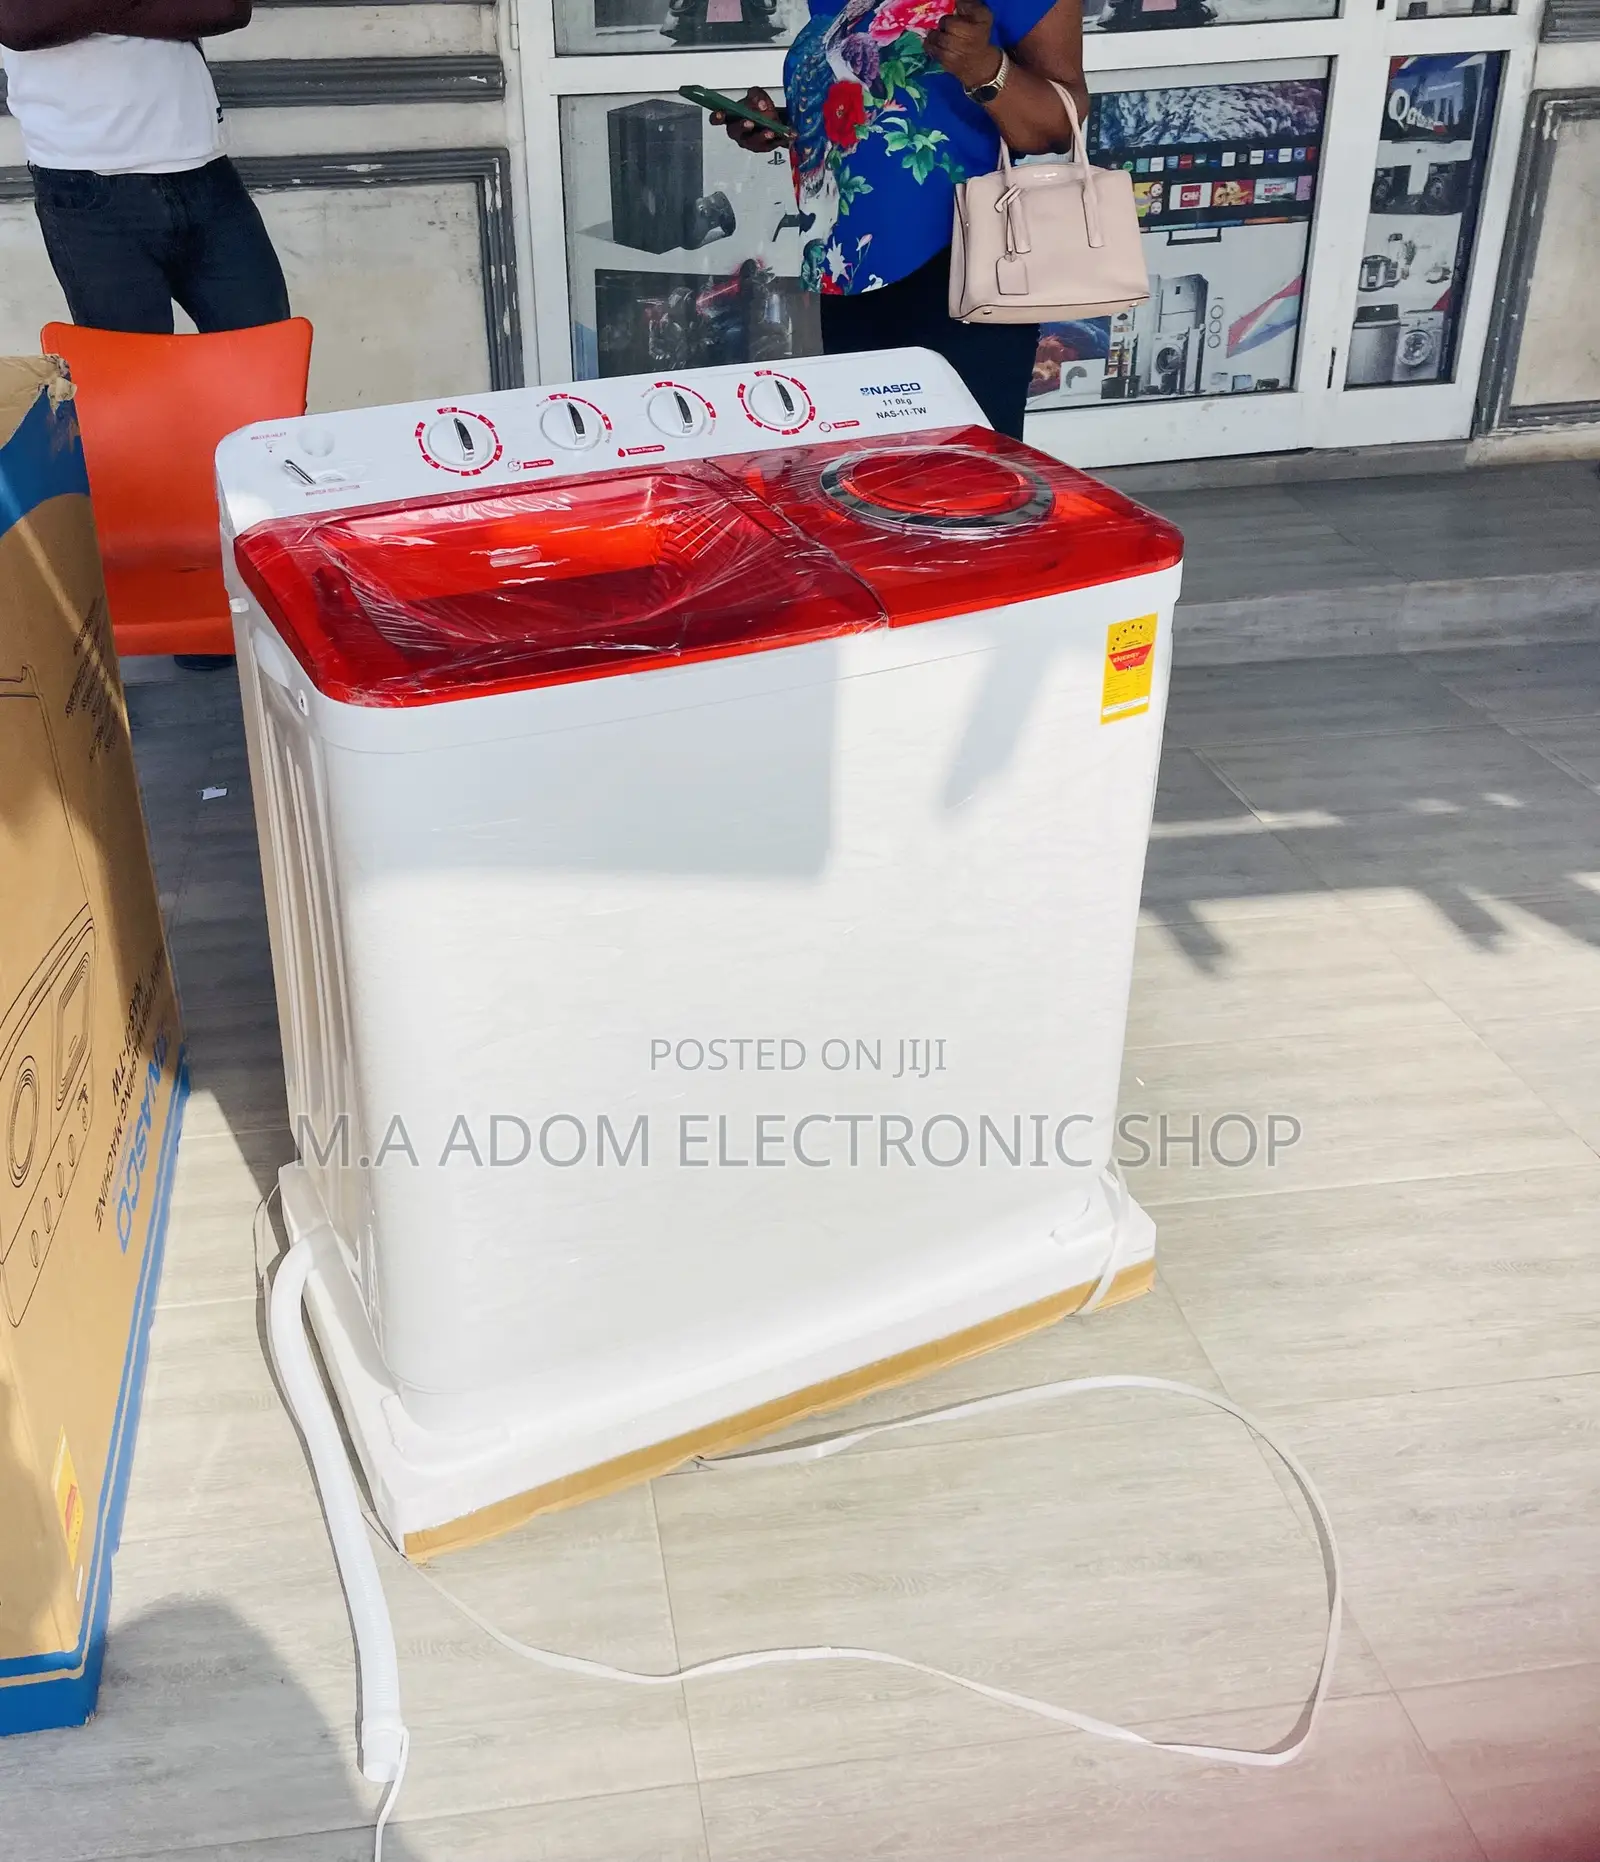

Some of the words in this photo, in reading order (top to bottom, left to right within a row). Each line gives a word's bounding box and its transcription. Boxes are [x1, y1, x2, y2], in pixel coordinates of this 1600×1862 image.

[870, 382, 921, 395] NASCO
[883, 398, 912, 406] 110kg
[876, 407, 927, 419] NAS-11-TW
[117, 1044, 163, 1254] NASCO
[95, 1115, 122, 1233] MACHINE
